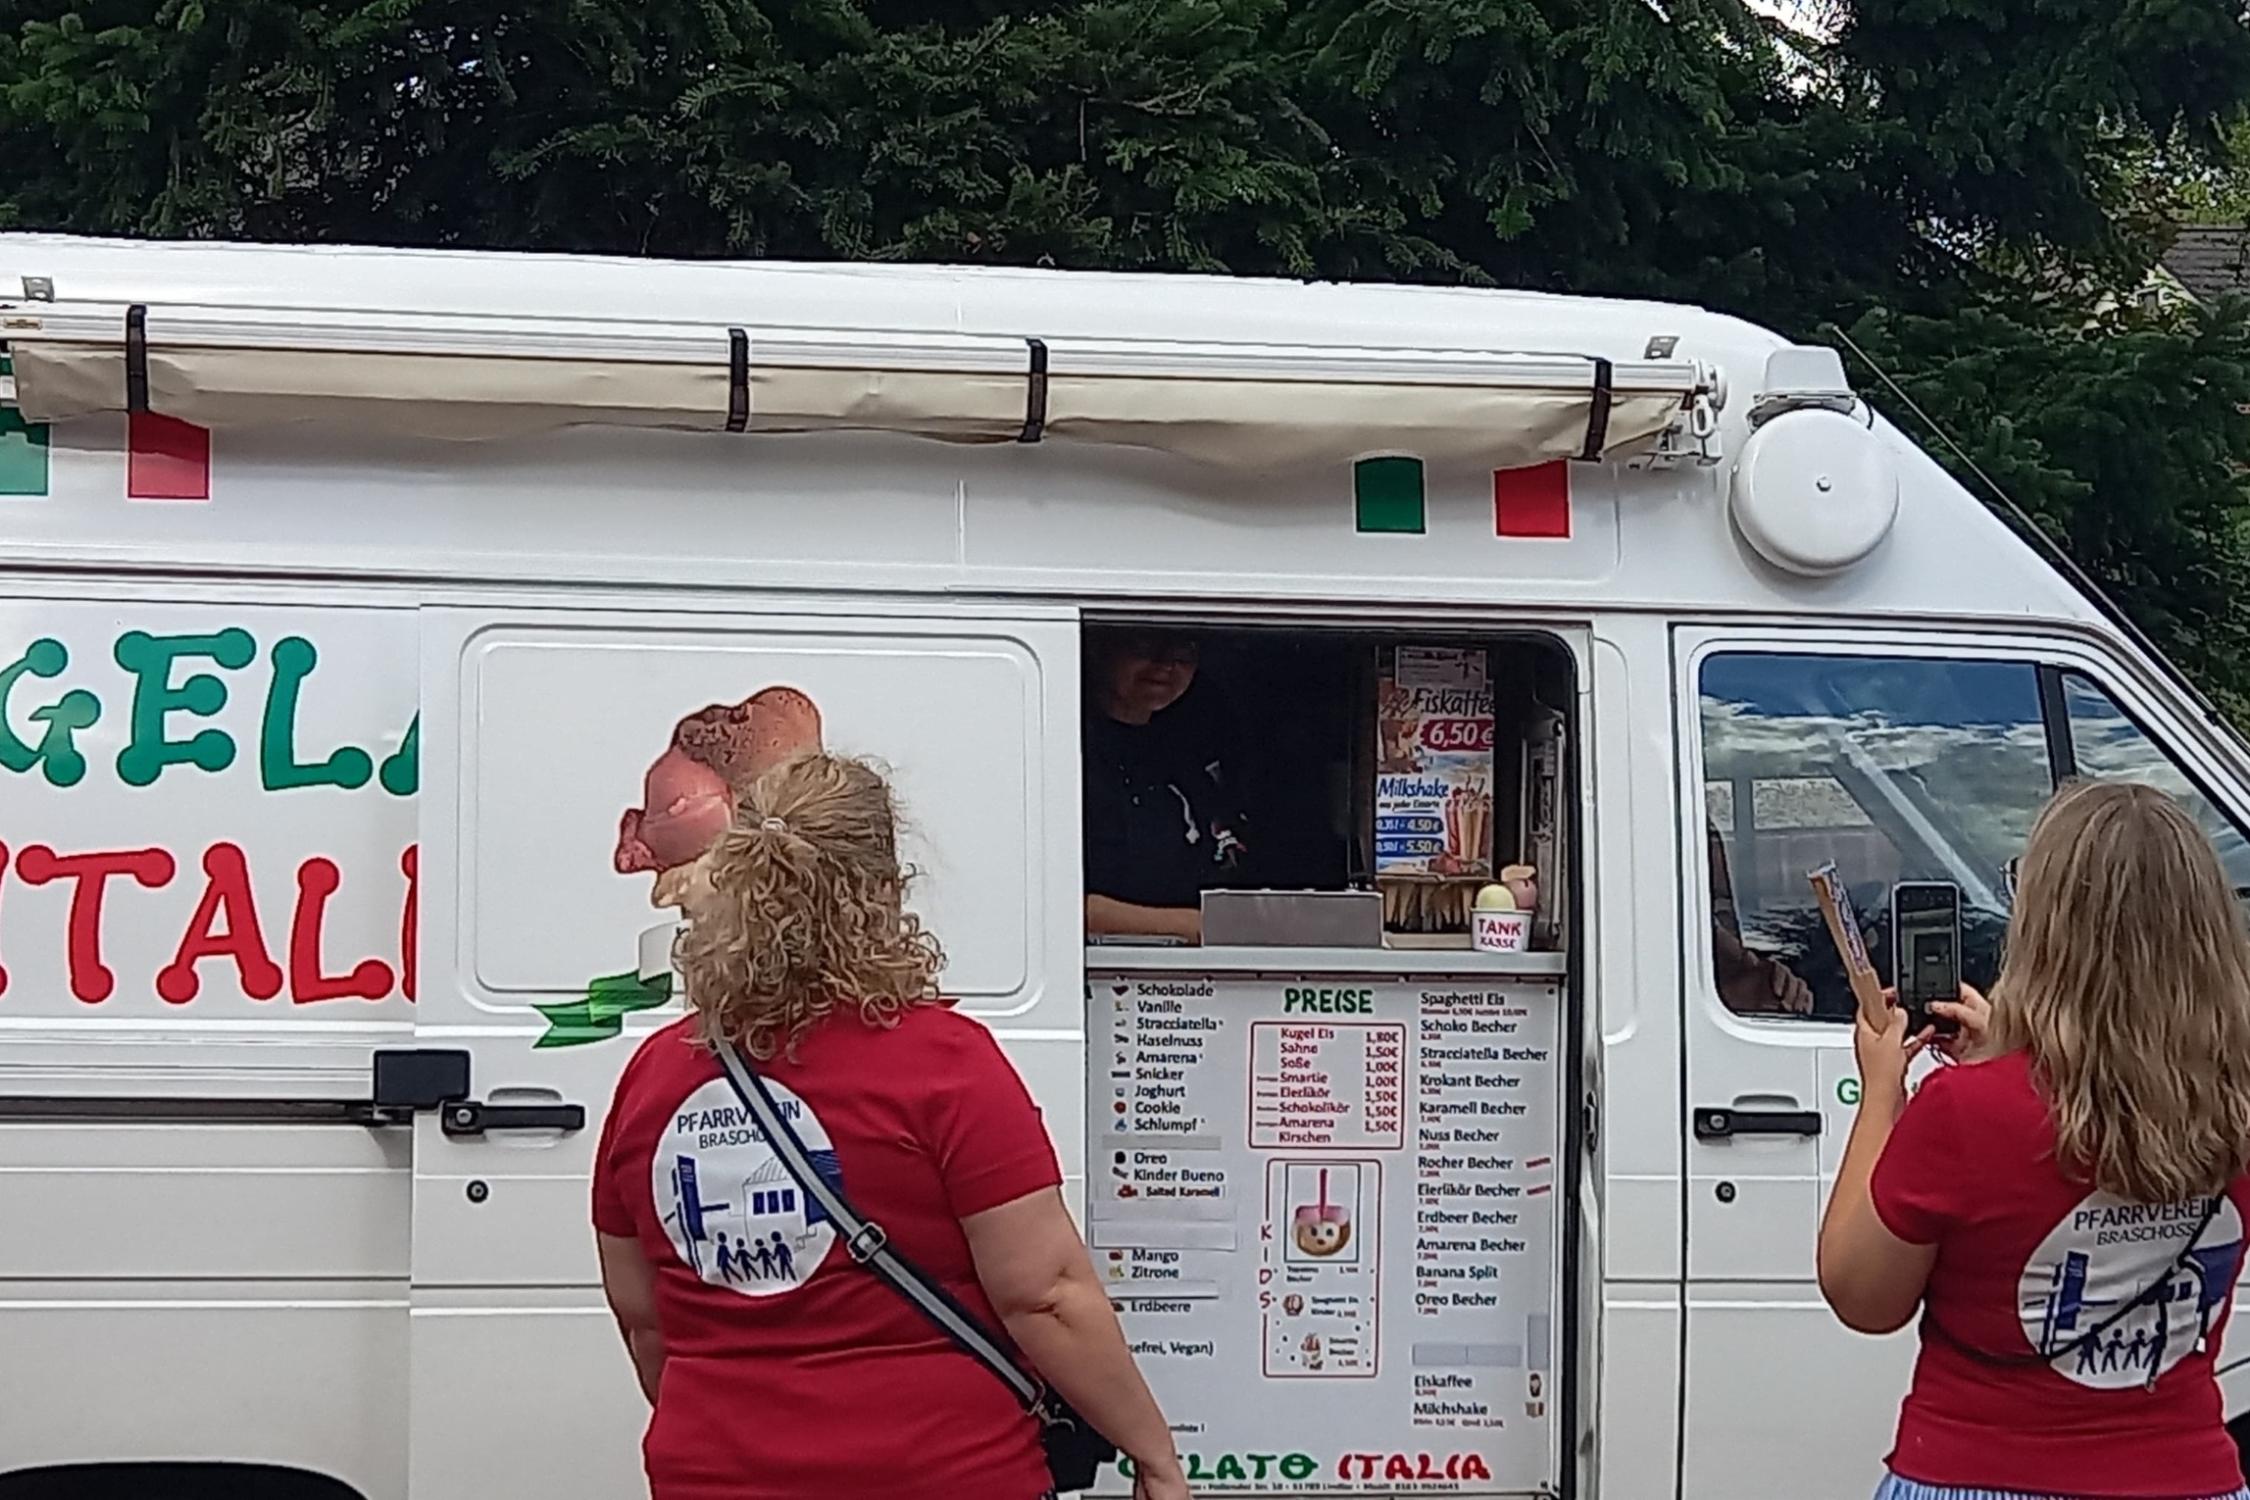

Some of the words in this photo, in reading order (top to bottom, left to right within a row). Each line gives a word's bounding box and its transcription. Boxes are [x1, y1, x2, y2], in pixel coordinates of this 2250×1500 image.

[1429, 722, 1478, 747] 6,50
[1378, 777, 1448, 798] Milkshake
[1479, 918, 1521, 936] TANK
[1480, 937, 1516, 949] KASSE
[1137, 983, 1214, 997] Schokolade
[1284, 988, 1373, 1013] PREISE
[1420, 992, 1483, 1007] Spaghetti
[1487, 992, 1505, 1005] Eis
[1138, 1000, 1182, 1013] Vanille
[1421, 1019, 1467, 1032] Schoko
[1472, 1020, 1517, 1033] Becher
[1137, 1033, 1203, 1047] Haselnuss
[1281, 1028, 1314, 1041] Kugel
[1318, 1028, 1334, 1039] Eis
[1280, 1043, 1318, 1054] Sahne
[1420, 1047, 1498, 1060] Stracciatella
[1502, 1048, 1548, 1061] Becher
[1280, 1057, 1311, 1069] Soße
[1136, 1068, 1184, 1080] Snicker
[1280, 1072, 1328, 1083] Smartie
[1420, 1073, 1471, 1087] Krokant
[1475, 1075, 1520, 1087] Becher
[1135, 1085, 1186, 1099] Joghurt
[1280, 1086, 1330, 1098] Eierlikör
[1135, 1101, 1181, 1114] Cookie
[1280, 1102, 1350, 1113] Schokolikör
[1419, 1101, 1477, 1114] Karamell
[1481, 1102, 1526, 1115] Becher
[677, 1100, 800, 1133] PFARRVIN
[1280, 1117, 1334, 1128] Amarena
[1279, 1131, 1331, 1143] Kirschen
[1419, 1128, 1450, 1141] Nuss
[1453, 1128, 1499, 1141] Becher
[1134, 1152, 1167, 1164] Oreo
[1418, 1156, 1464, 1169] Rocher
[1467, 1156, 1513, 1169] Becher
[1134, 1168, 1177, 1181] Kinder
[1181, 1169, 1224, 1182] Bueno
[1418, 1183, 1472, 1196] Eierlikör
[1475, 1183, 1520, 1197] Becher
[1417, 1211, 1469, 1223] Erdbeer
[1472, 1211, 1518, 1224] Becher
[1416, 1238, 1476, 1250] Amarena
[1480, 1238, 1526, 1251] Becher
[1132, 1250, 1179, 1263] Mango
[1131, 1266, 1179, 1278] Zitrone
[1416, 1266, 1465, 1278] Banana
[1469, 1265, 1498, 1280] Split
[1415, 1293, 1449, 1306] Oreo
[1452, 1292, 1497, 1306] Becher
[1131, 1300, 1191, 1312] Erdbeere
[1170, 1341, 1214, 1356] Vegan)
[1414, 1375, 1473, 1388] Eiskaffee
[1338, 1453, 1490, 1479] ITALIA
